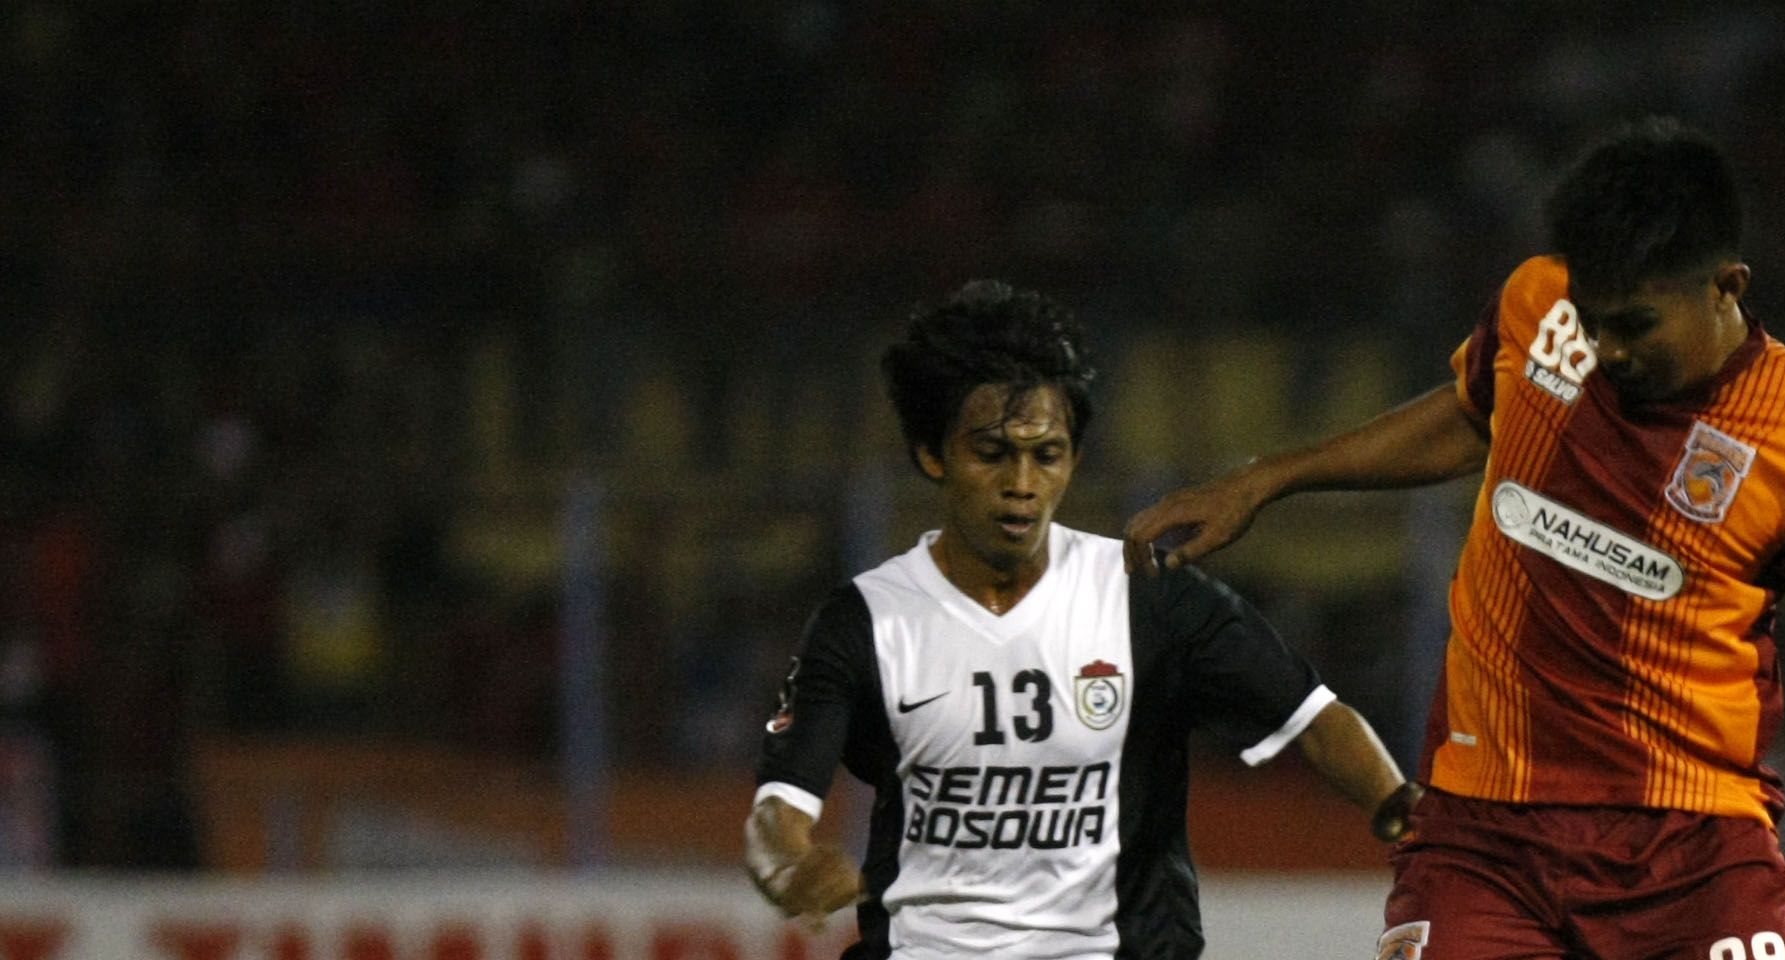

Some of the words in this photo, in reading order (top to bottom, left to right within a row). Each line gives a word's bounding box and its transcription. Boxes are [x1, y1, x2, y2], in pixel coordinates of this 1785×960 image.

[1531, 507, 1670, 581] NAHUSAM
[972, 668, 1054, 746] 13
[910, 761, 1111, 806] SEMEN
[905, 802, 1106, 850] BOSOWA
